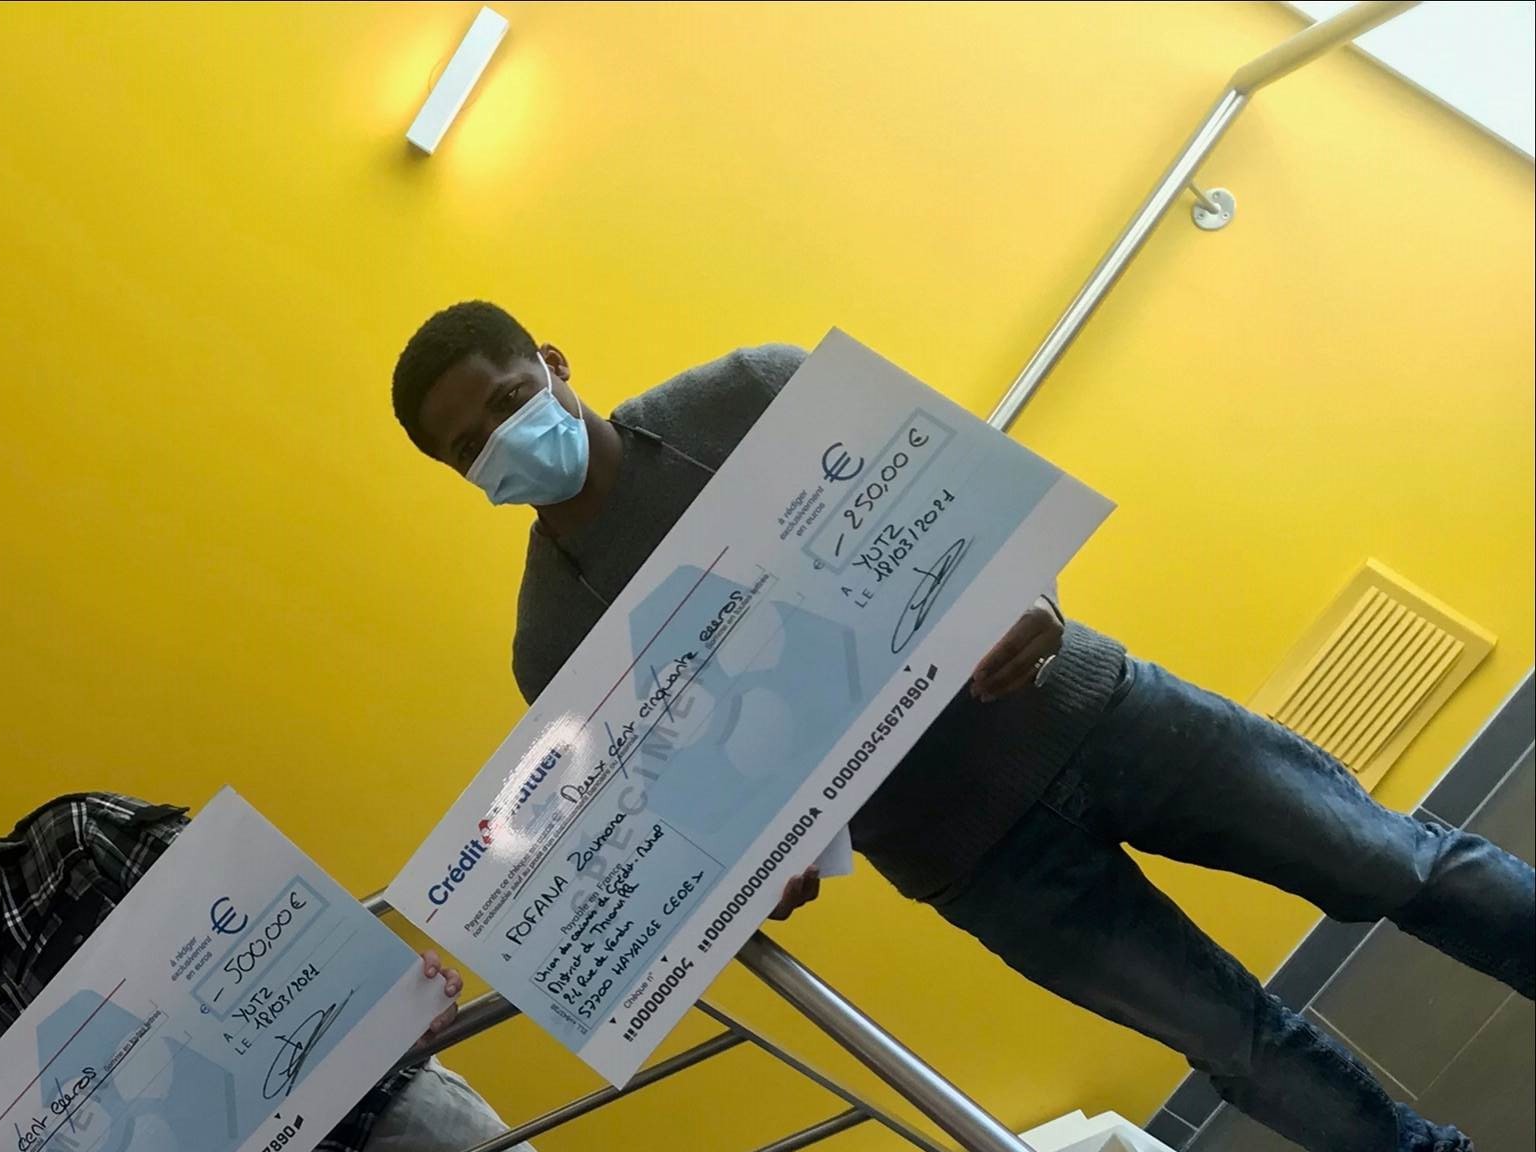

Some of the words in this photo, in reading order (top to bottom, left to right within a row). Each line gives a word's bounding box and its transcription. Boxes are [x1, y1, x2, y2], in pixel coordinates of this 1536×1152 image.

[850, 516, 906, 575] YUTZ
[424, 835, 489, 908] Crédit
[504, 871, 571, 947] FOFANA
[621, 979, 650, 1011] Chèque
